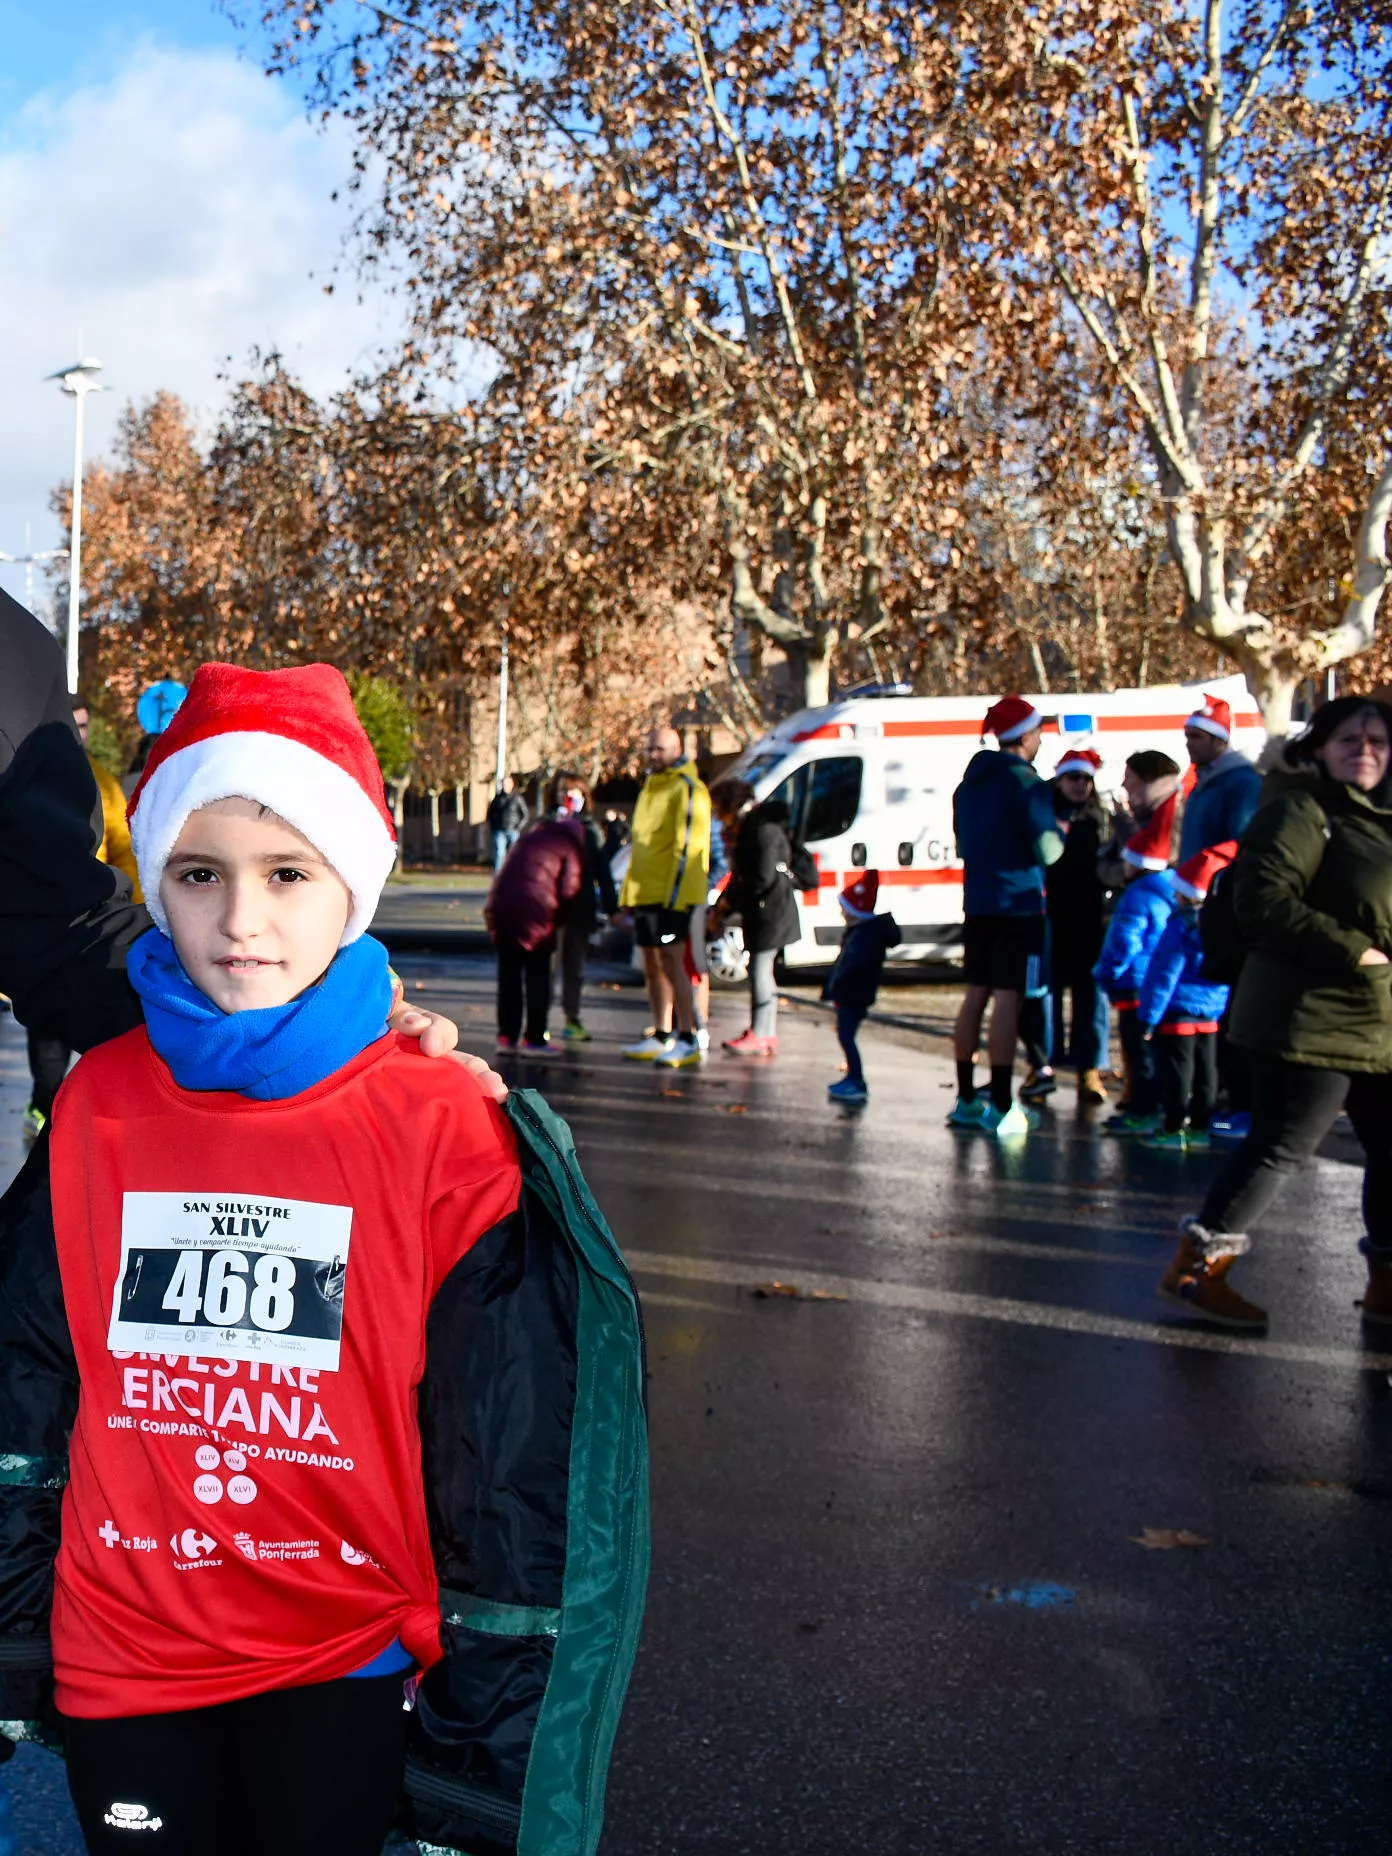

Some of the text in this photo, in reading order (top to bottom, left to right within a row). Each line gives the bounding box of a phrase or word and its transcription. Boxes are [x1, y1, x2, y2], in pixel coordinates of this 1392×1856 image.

[183, 1202, 292, 1220] SAN SILVESTRE
[209, 1216, 270, 1238] XLIV
[199, 1238, 232, 1247] comparte
[232, 1239, 259, 1249] tiempo
[161, 1249, 297, 1332] 468
[122, 1367, 340, 1446] ERCIANA
[264, 1446, 355, 1471] AYUDANDO
[198, 1485, 218, 1493] XLVII
[233, 1485, 251, 1493] XLVI
[133, 1536, 158, 1553] Roja
[258, 1539, 320, 1550] Ayuntamiento
[258, 1548, 320, 1561] Ponferrada
